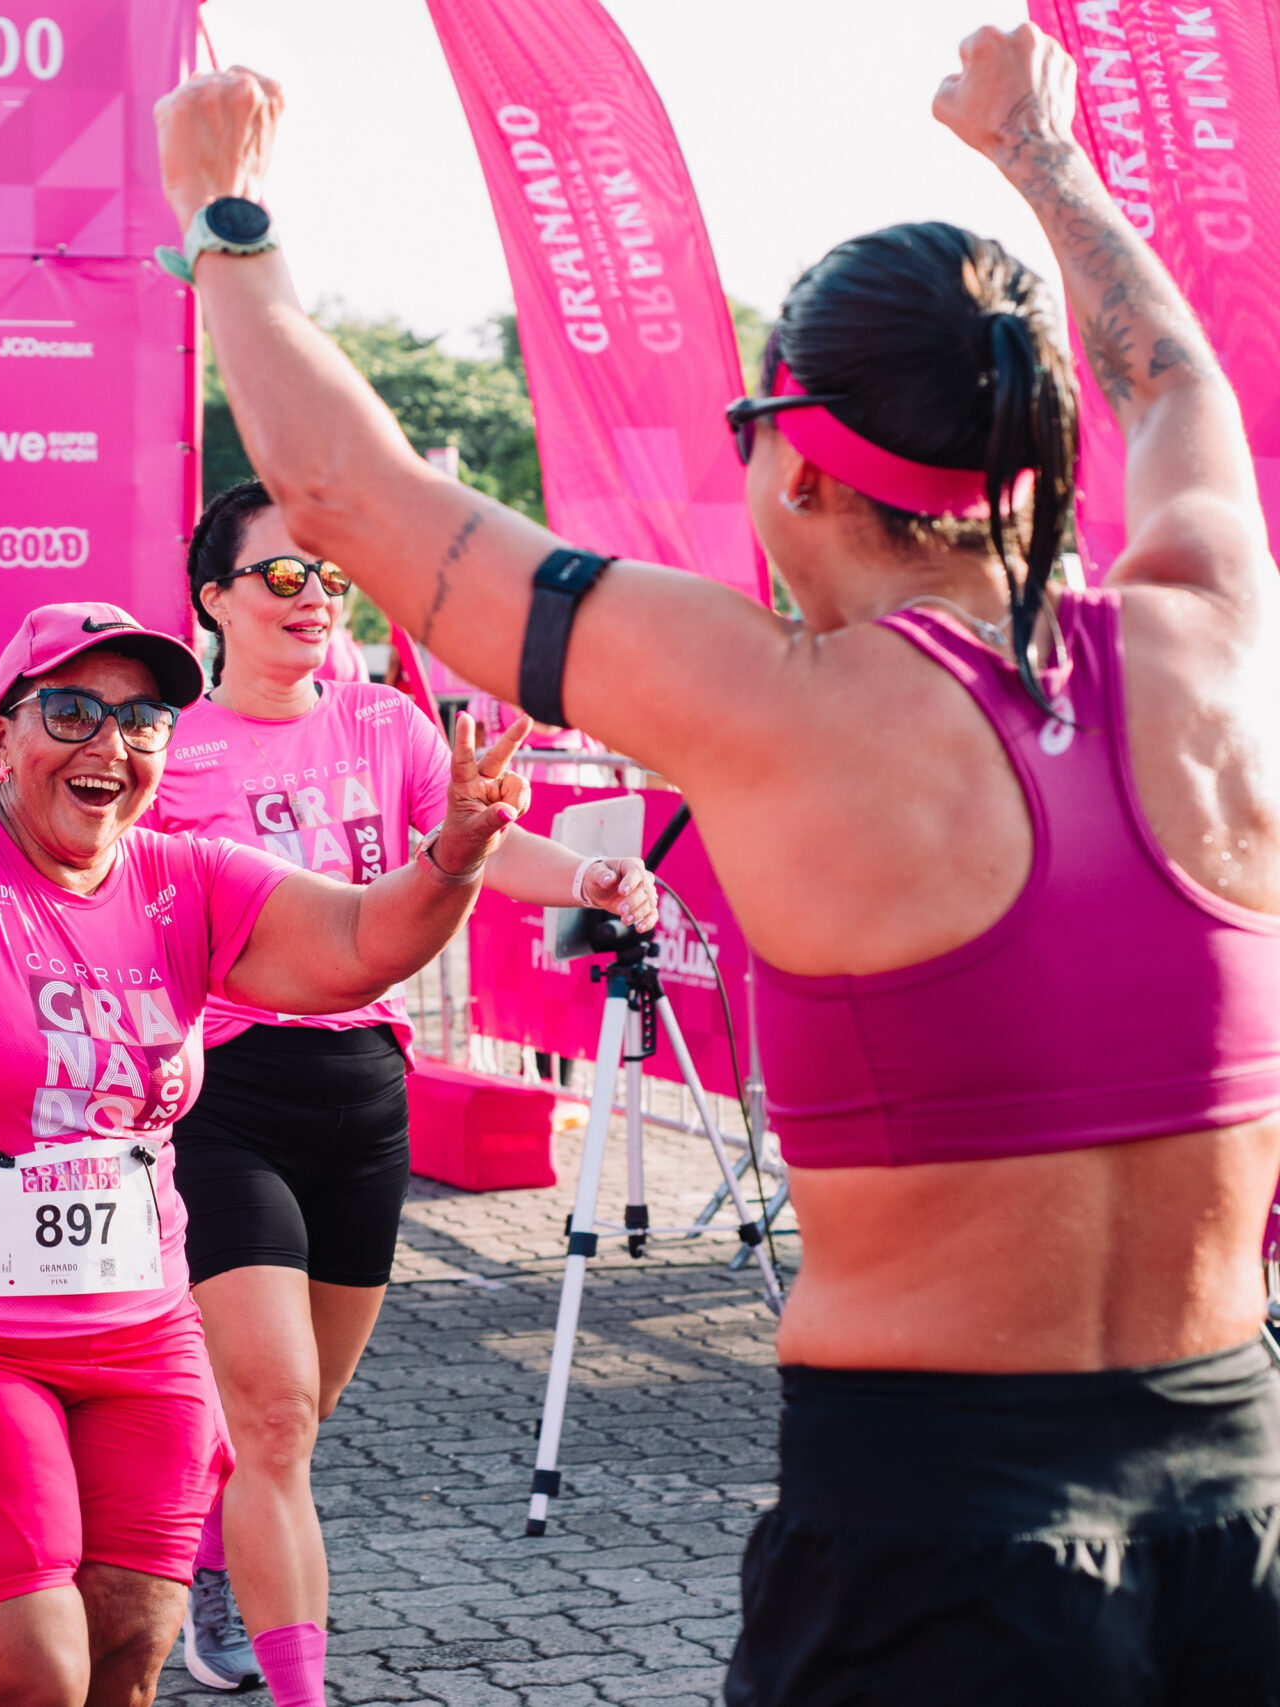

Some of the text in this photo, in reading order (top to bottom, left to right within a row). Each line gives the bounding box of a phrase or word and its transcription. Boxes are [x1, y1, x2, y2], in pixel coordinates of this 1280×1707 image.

[1171, 6, 1234, 149] PINK
[497, 104, 609, 354] GRANADO
[595, 169, 662, 278] PINK
[174, 739, 228, 761] GRANADO
[194, 758, 220, 771] PINK
[243, 756, 370, 791] CORRIDA
[255, 777, 380, 833] GRA
[354, 826, 382, 884] 202
[26, 952, 163, 985] CORRIDA
[38, 980, 181, 1044] GRA
[45, 1032, 145, 1099] NA
[39, 1090, 135, 1138] DO
[24, 1156, 120, 1177] CORRIDA
[24, 1173, 121, 1193] GRANADO
[35, 1202, 117, 1248] 897
[39, 1263, 78, 1273] GRANADO
